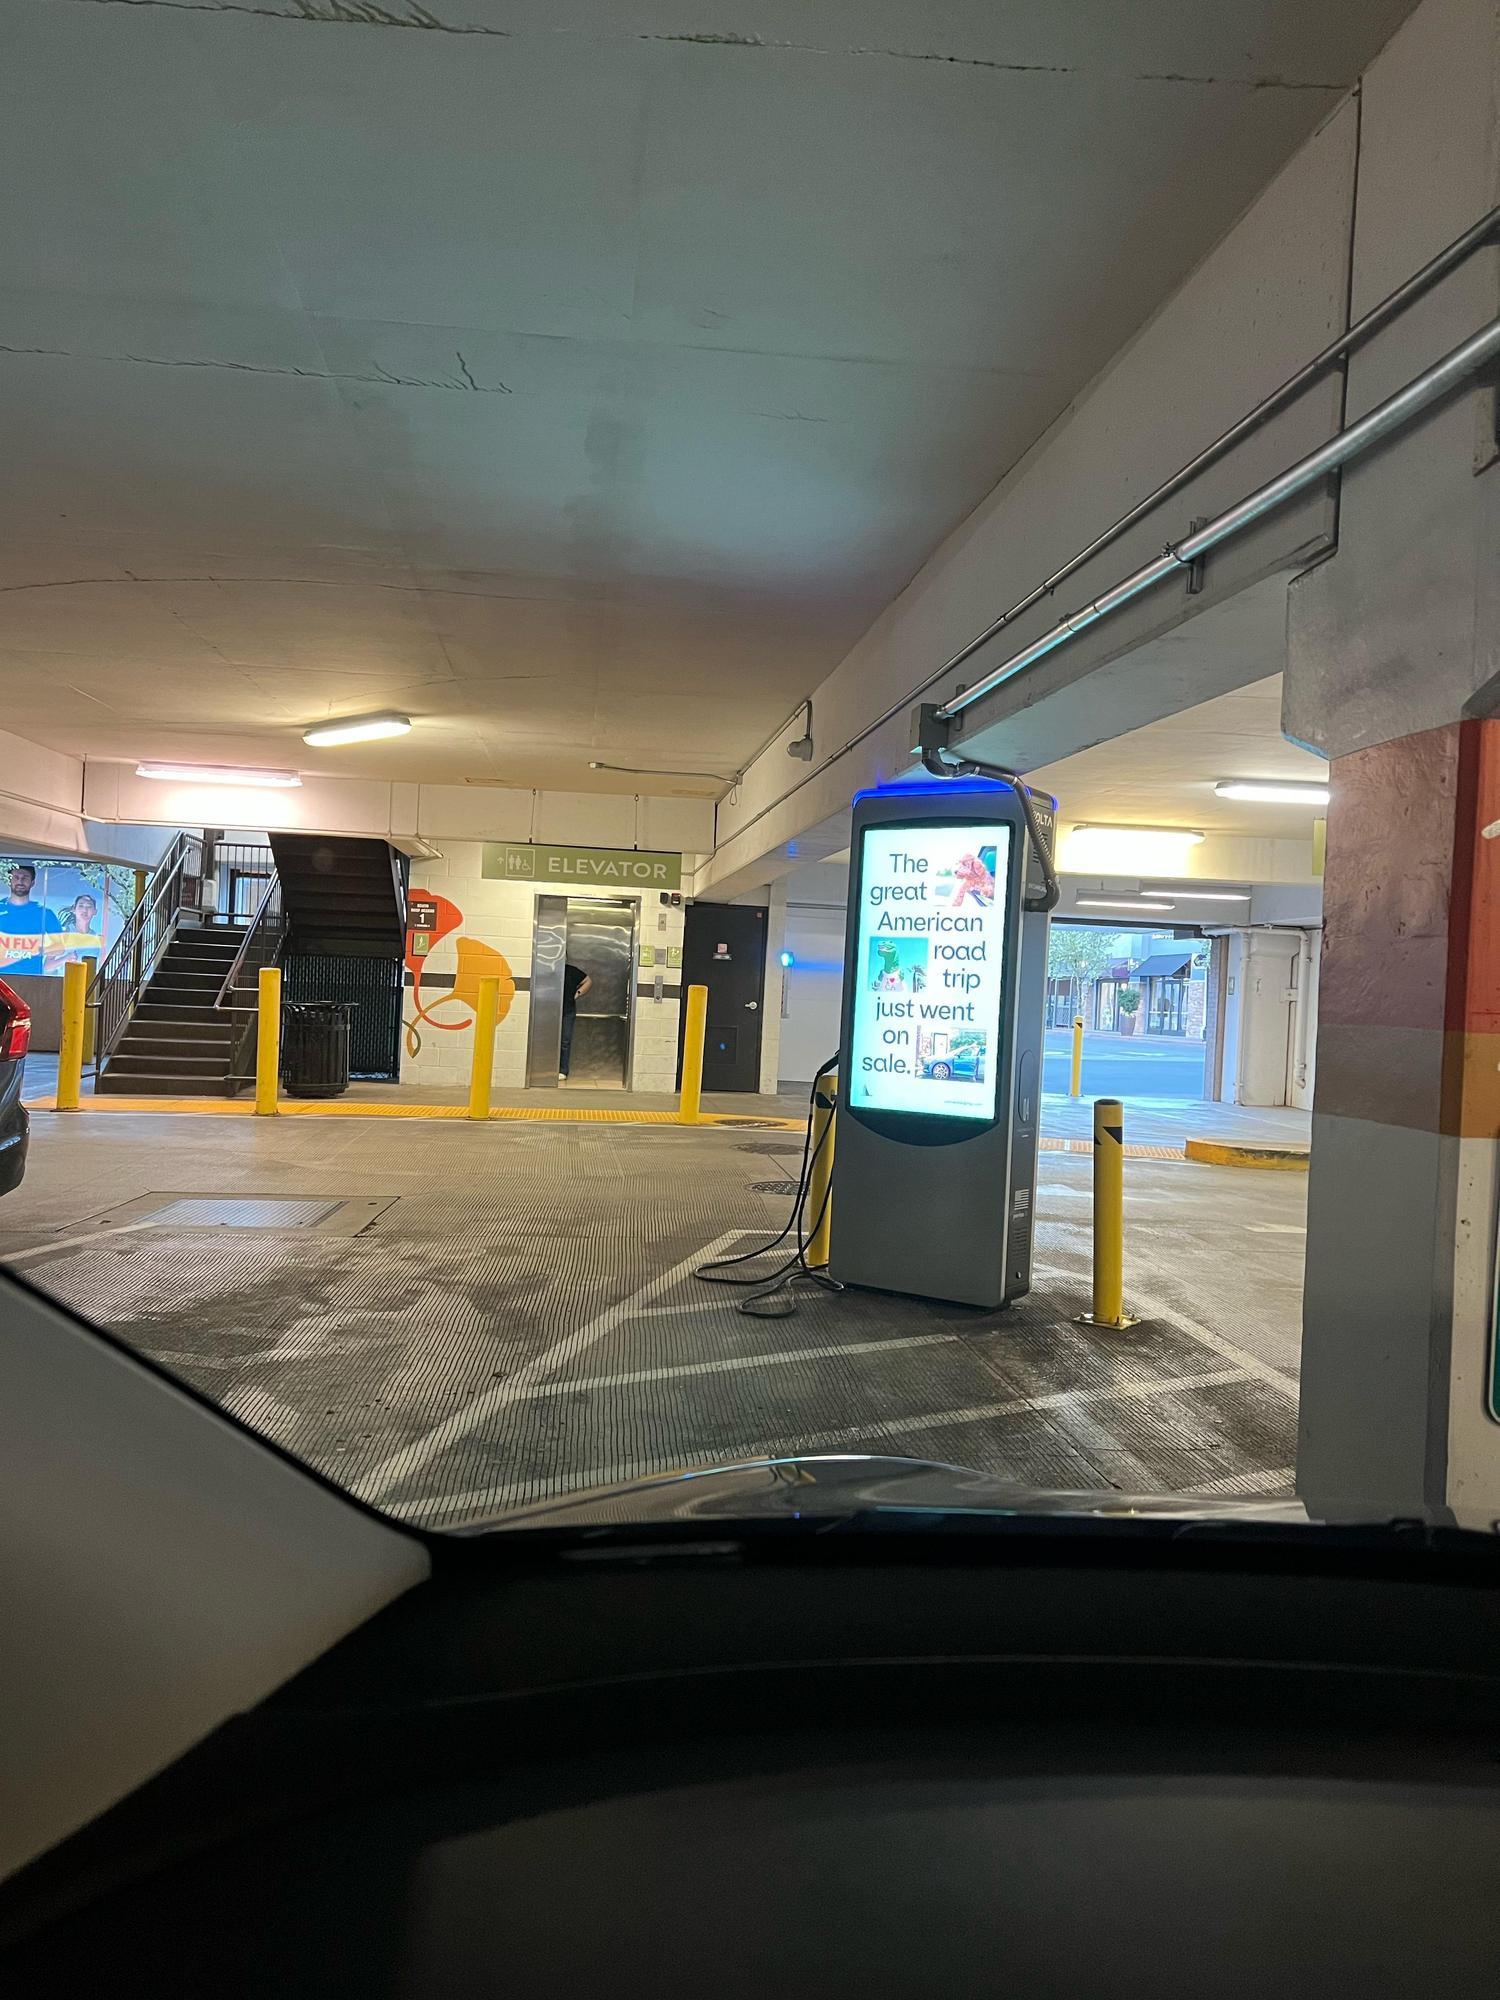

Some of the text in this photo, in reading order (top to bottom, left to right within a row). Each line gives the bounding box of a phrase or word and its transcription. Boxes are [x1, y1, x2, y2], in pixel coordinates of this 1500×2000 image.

[548, 856, 667, 880] ELEVATOR
[889, 853, 929, 873] The
[870, 881, 927, 906] great
[419, 913, 425, 924] 1
[877, 911, 984, 932] American
[13, 937, 38, 950] FLY
[934, 940, 987, 961] road
[5, 950, 33, 960] HOKA
[943, 968, 981, 994] trip
[876, 996, 975, 1022] just went
[883, 1029, 909, 1046] on
[862, 1053, 911, 1075] sale.
